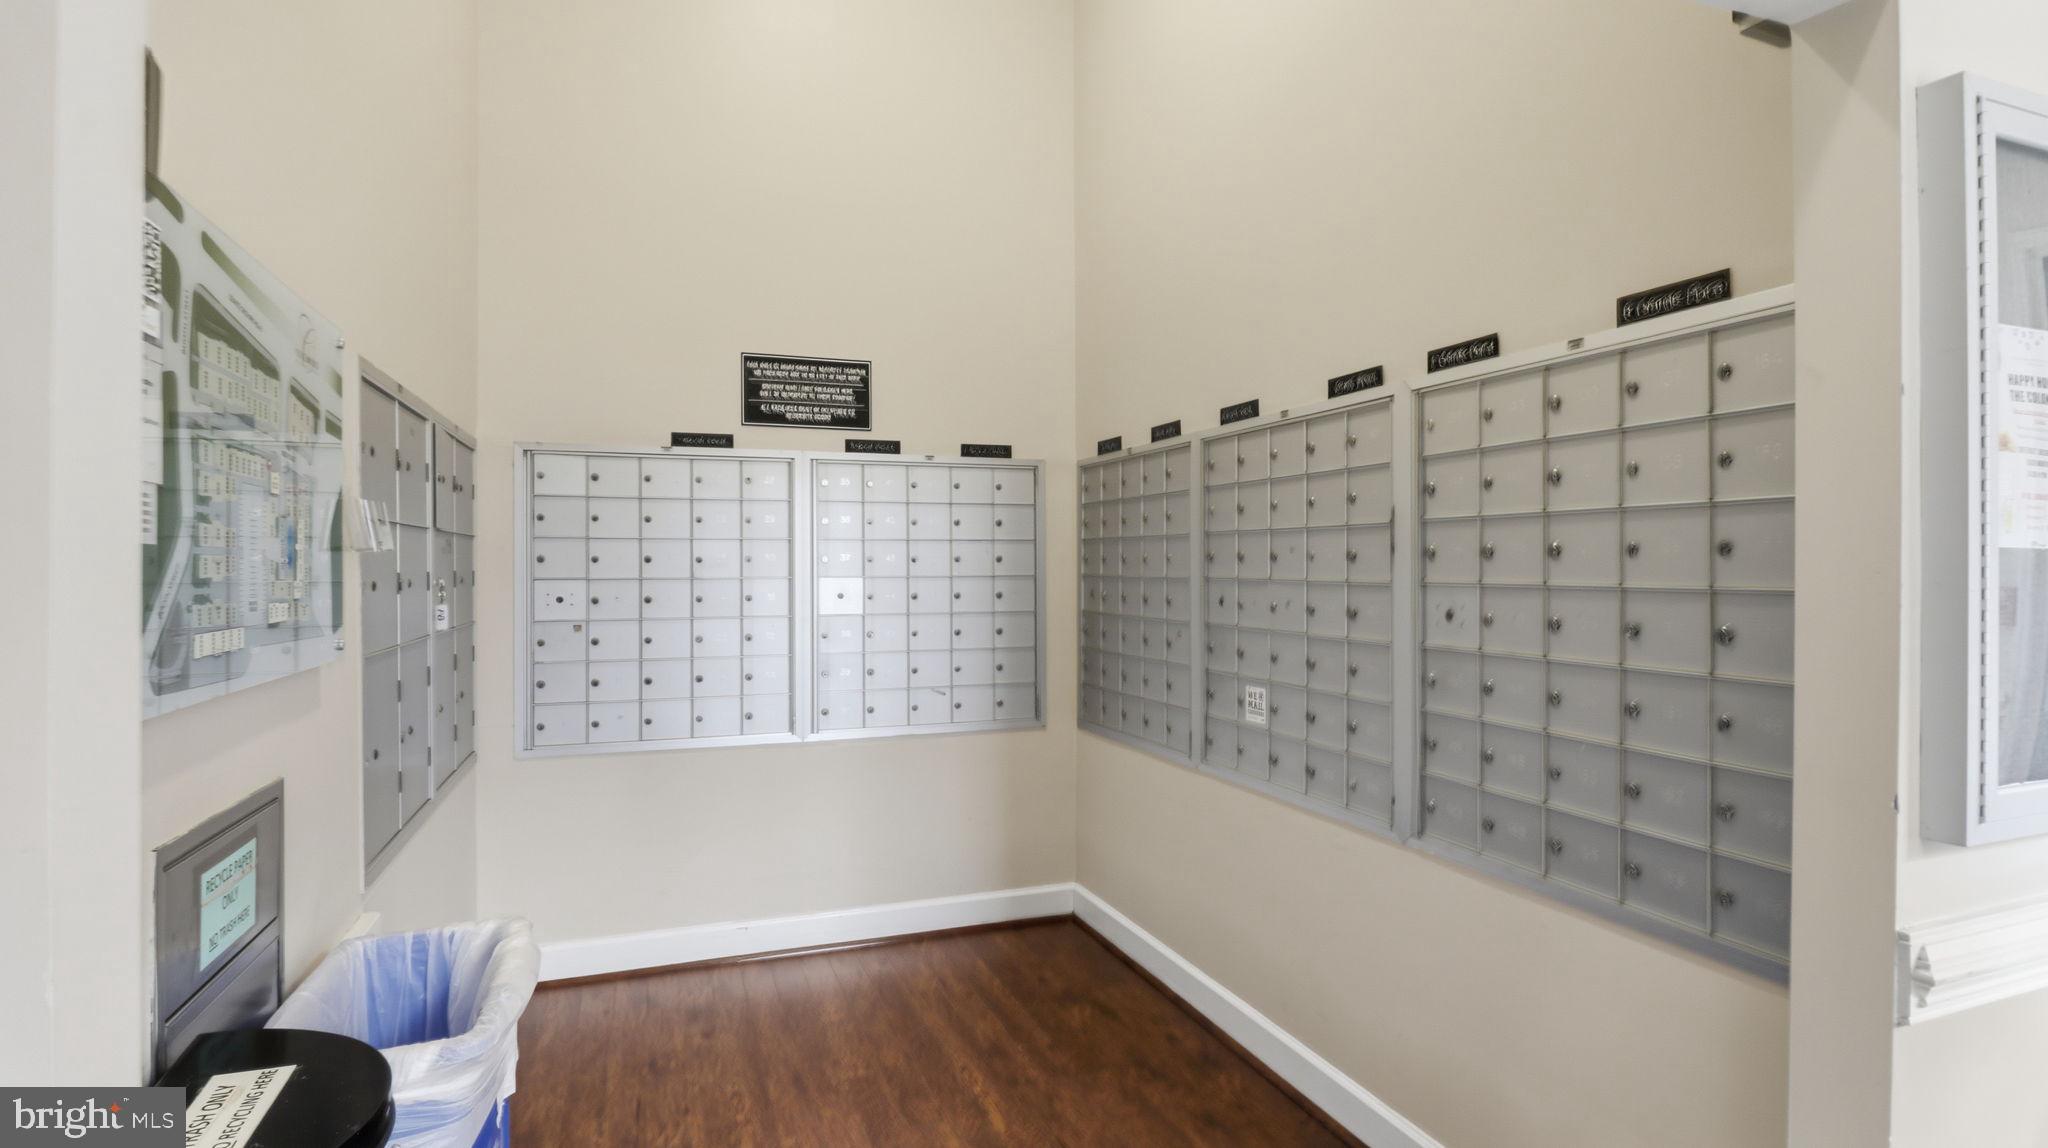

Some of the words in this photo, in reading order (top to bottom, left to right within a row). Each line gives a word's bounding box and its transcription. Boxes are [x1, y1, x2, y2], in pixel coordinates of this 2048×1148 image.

[206, 864, 233, 895] RECYCLE
[234, 850, 253, 873] PAPER
[222, 885, 240, 910] ONLY
[202, 1085, 236, 1112] ONLY
[218, 1091, 264, 1140] RECYCLING
[251, 1069, 279, 1091] HERE
